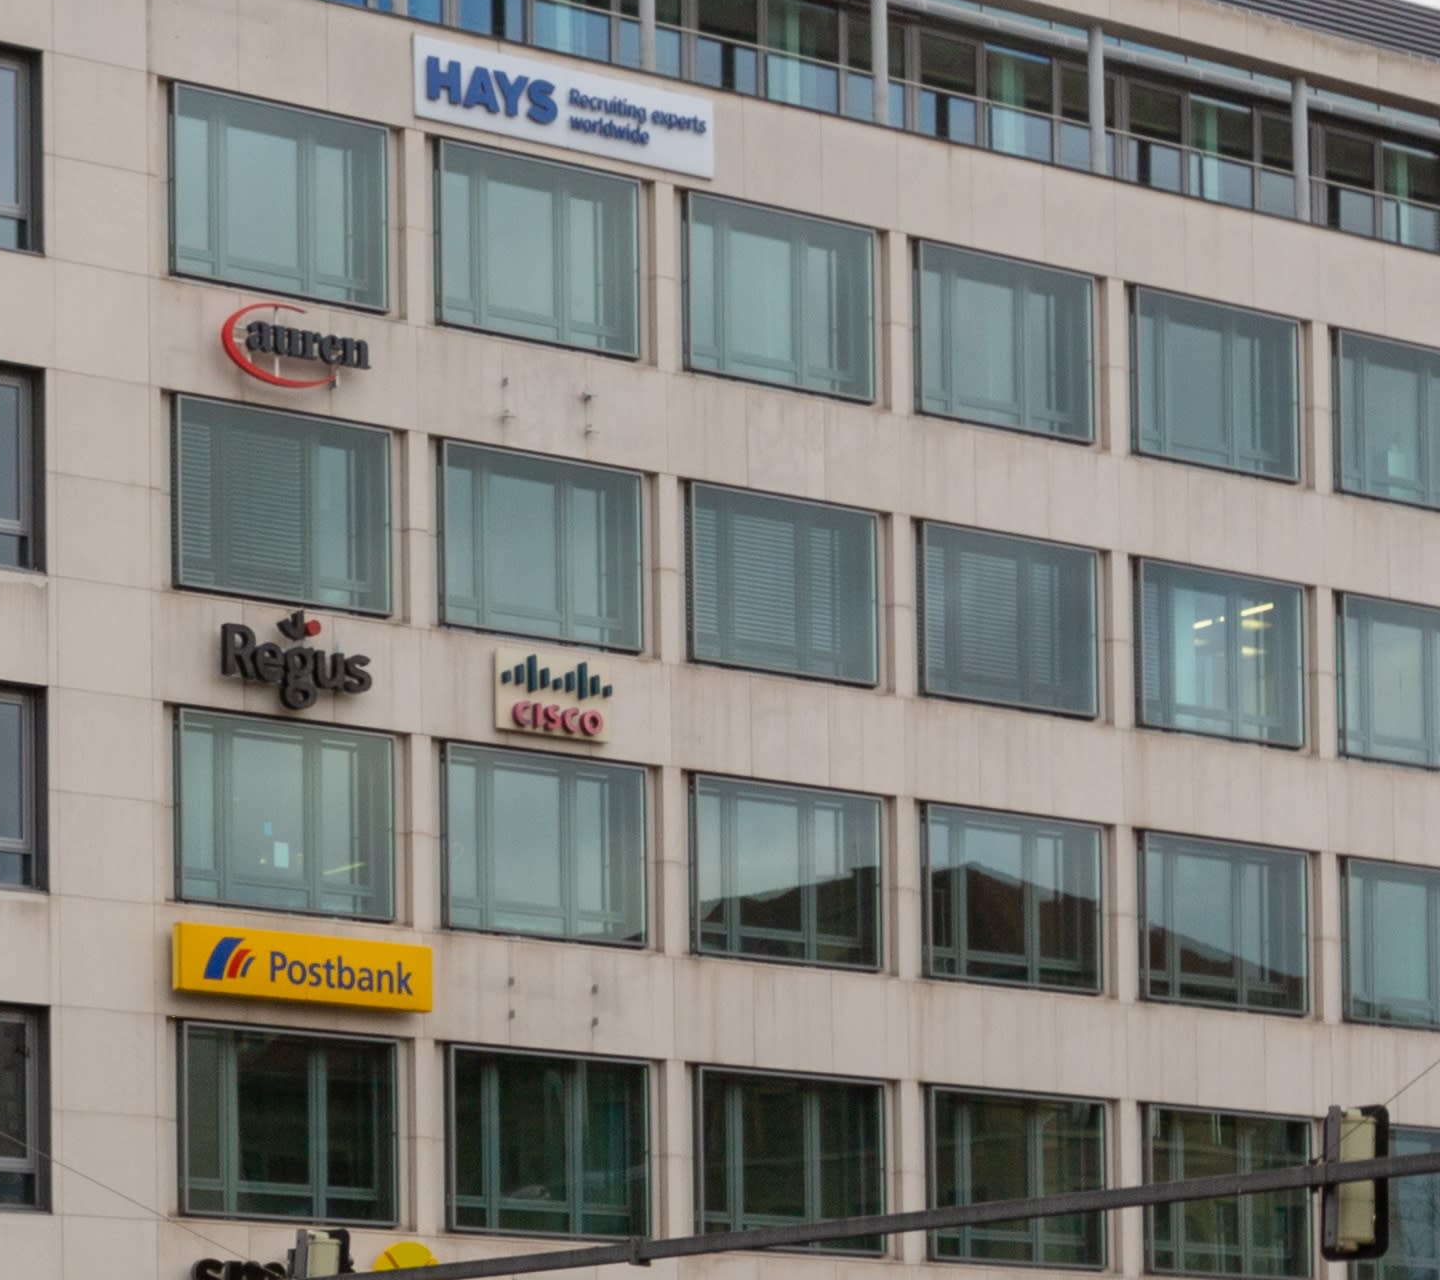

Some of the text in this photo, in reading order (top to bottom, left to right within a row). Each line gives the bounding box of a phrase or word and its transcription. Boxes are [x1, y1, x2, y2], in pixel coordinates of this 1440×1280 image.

[425, 54, 708, 135] HAYS Recruiting experts
[569, 115, 650, 146] worldwide
[245, 320, 372, 370] auren
[220, 622, 373, 711] Regus
[269, 949, 414, 997] Postbank
